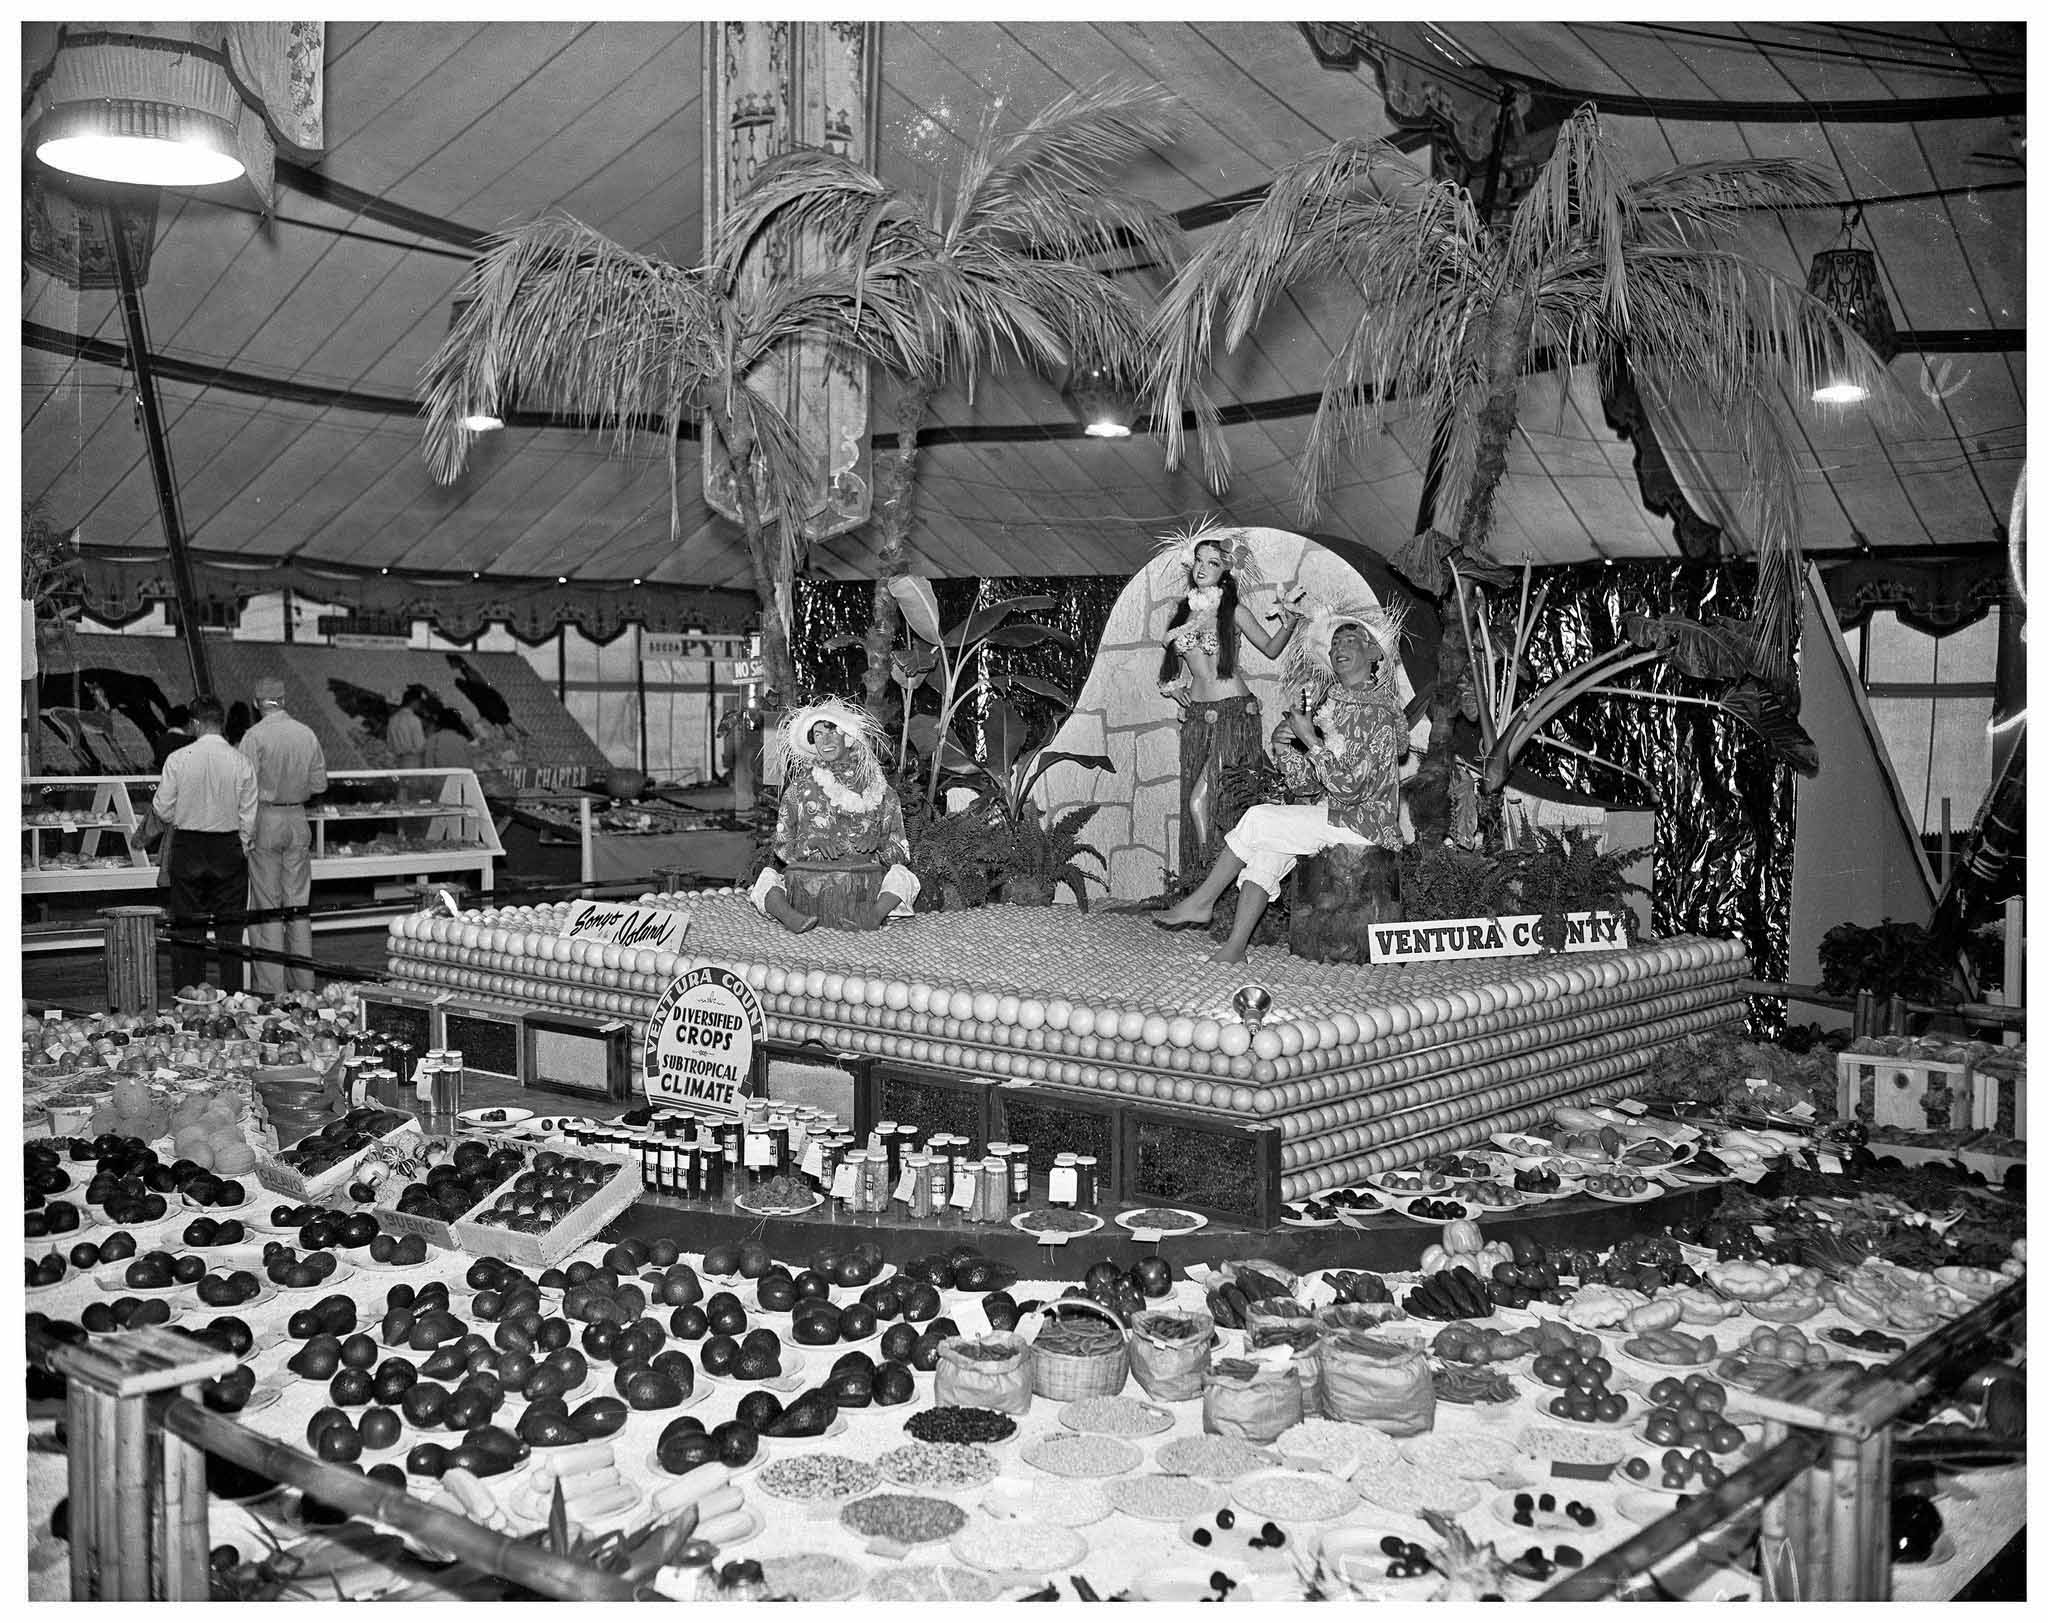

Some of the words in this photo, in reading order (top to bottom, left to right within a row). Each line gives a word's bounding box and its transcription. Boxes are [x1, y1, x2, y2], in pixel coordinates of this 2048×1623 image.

[735, 661, 749, 678] NO
[612, 910, 677, 946] Island
[1376, 924, 1503, 956] VENTURA
[1513, 918, 1620, 947] CONTY
[647, 969, 712, 1054] VENTURA
[722, 974, 764, 1042] COUNT
[673, 1006, 742, 1031] DIVERSIFIED
[676, 1024, 733, 1051] CROPS
[662, 1054, 737, 1081] SUBTROPICAL
[661, 1073, 735, 1104] CLIMATE
